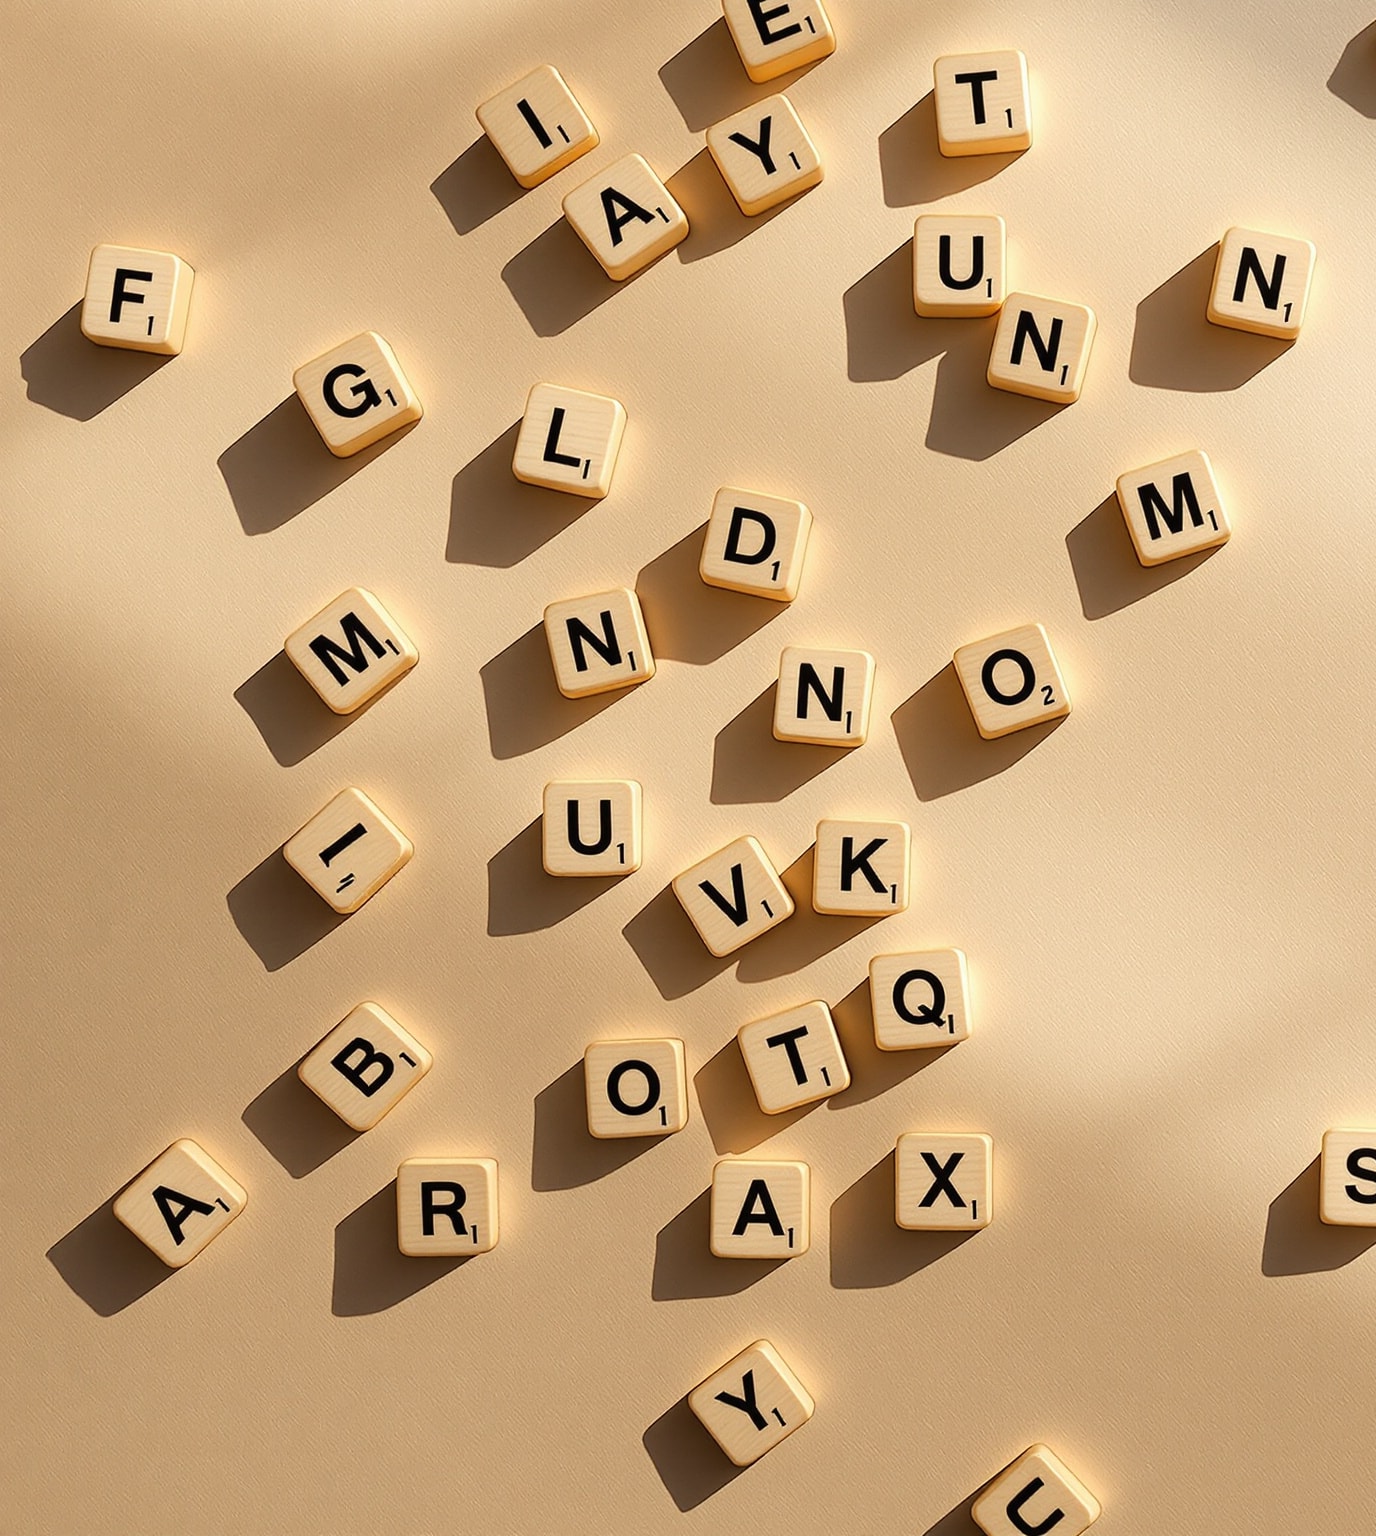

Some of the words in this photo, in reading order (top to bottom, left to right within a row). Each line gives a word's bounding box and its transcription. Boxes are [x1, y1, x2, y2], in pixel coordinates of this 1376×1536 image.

[746, 0, 803, 46] E
[954, 70, 998, 125] T
[727, 115, 777, 176] Y
[600, 186, 656, 248] A
[938, 234, 984, 291] U
[1232, 246, 1287, 311] N
[109, 268, 153, 323] F
[1009, 310, 1064, 373] N
[322, 363, 383, 419] G
[543, 407, 581, 468] L
[723, 506, 777, 566] D
[1137, 471, 1205, 541] M
[308, 611, 387, 687] M
[565, 610, 623, 673] N
[796, 662, 845, 722] N
[981, 648, 1036, 706] O
[567, 799, 612, 856] U
[698, 863, 749, 927] V
[840, 836, 889, 894] K
[892, 969, 947, 1028] Q
[330, 1037, 395, 1098] B
[765, 1025, 809, 1086] T
[606, 1059, 661, 1116] O
[420, 1181, 469, 1236] R
[731, 1179, 785, 1237] A
[917, 1152, 967, 1208] X
[151, 1185, 216, 1247] A
[714, 1369, 769, 1432] Y
